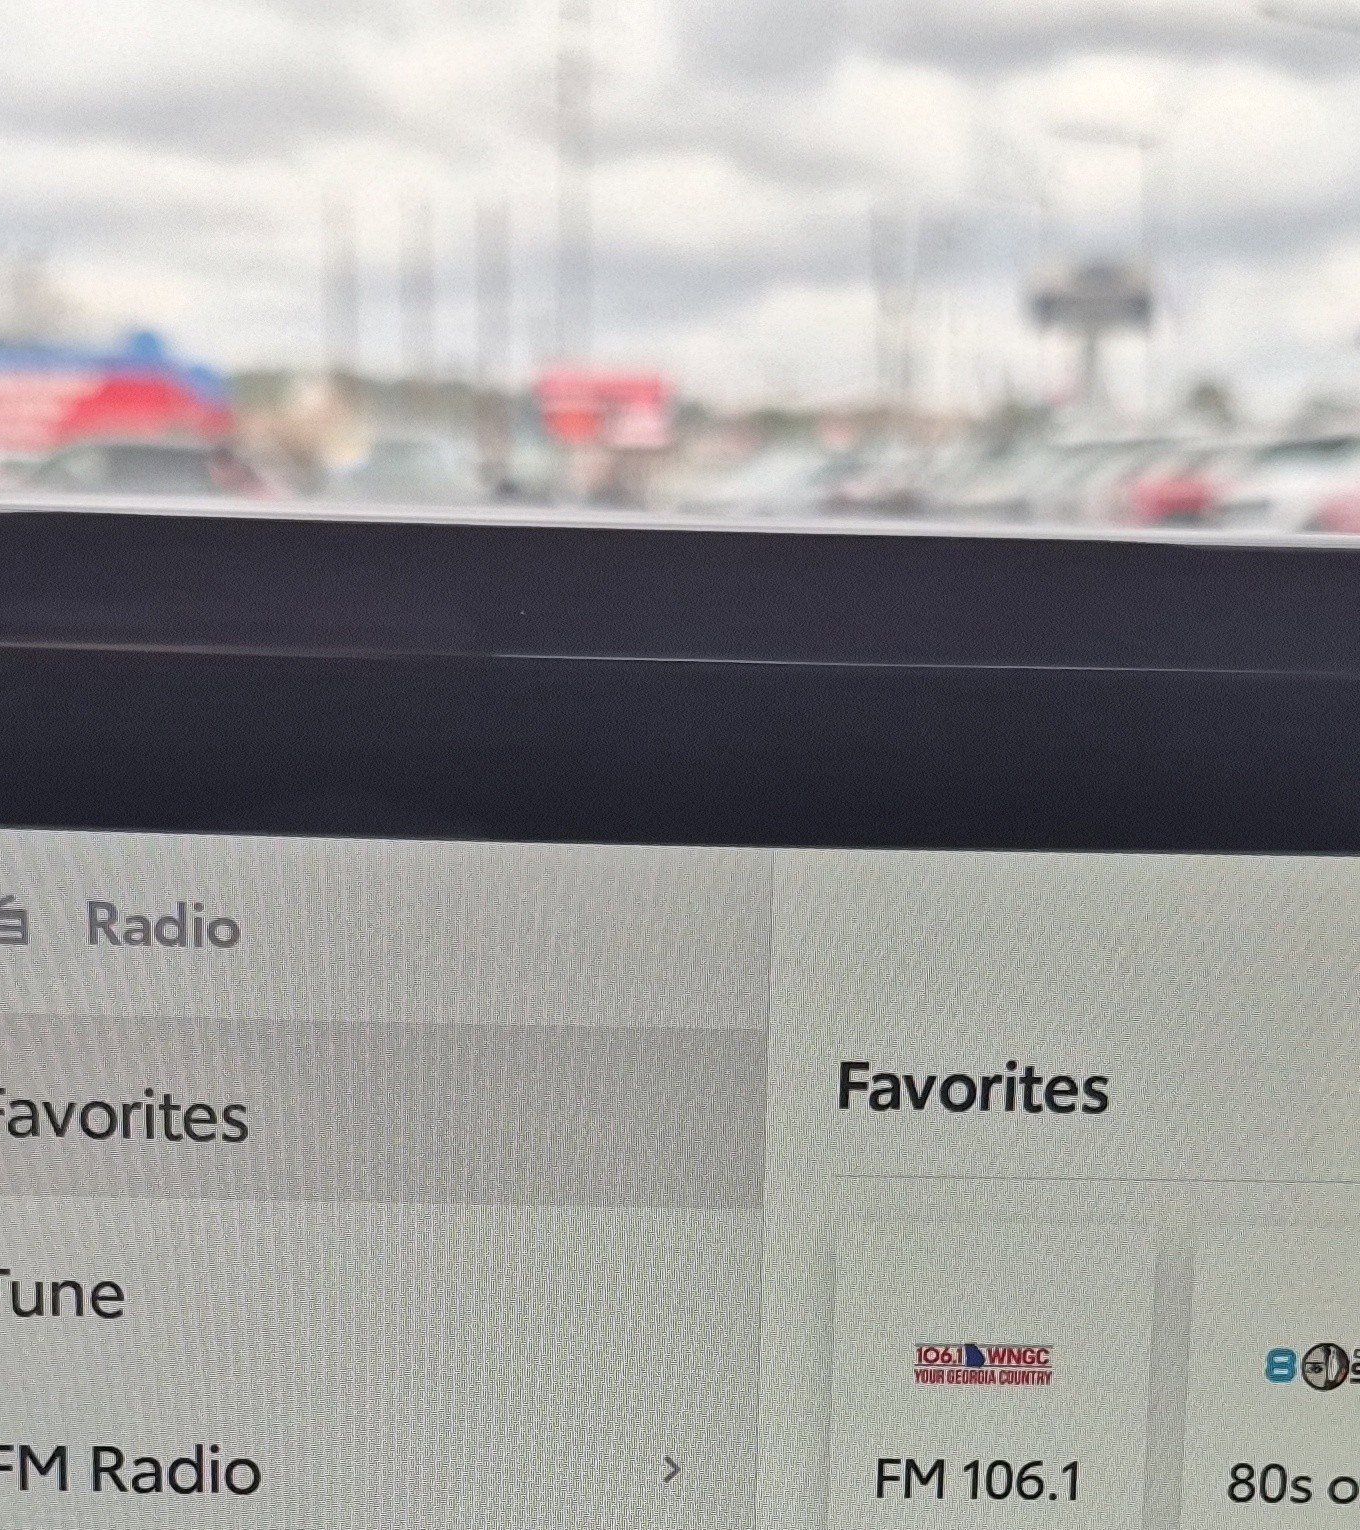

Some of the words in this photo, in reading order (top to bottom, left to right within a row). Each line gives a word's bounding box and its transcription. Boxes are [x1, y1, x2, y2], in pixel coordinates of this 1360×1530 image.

[87, 901, 240, 949] Radio
[839, 1060, 1109, 1115] Favorites
[914, 1369, 944, 1384] YOUR
[947, 1369, 996, 1385] GEORGIA
[999, 1370, 1052, 1385] COUNTRY
[916, 1346, 962, 1364] 106.1
[987, 1347, 1050, 1365] WNGC
[92, 1445, 261, 1495] Radio
[876, 1458, 944, 1500] FM
[963, 1460, 1080, 1501] 106.1
[1228, 1463, 1312, 1504] 80s
